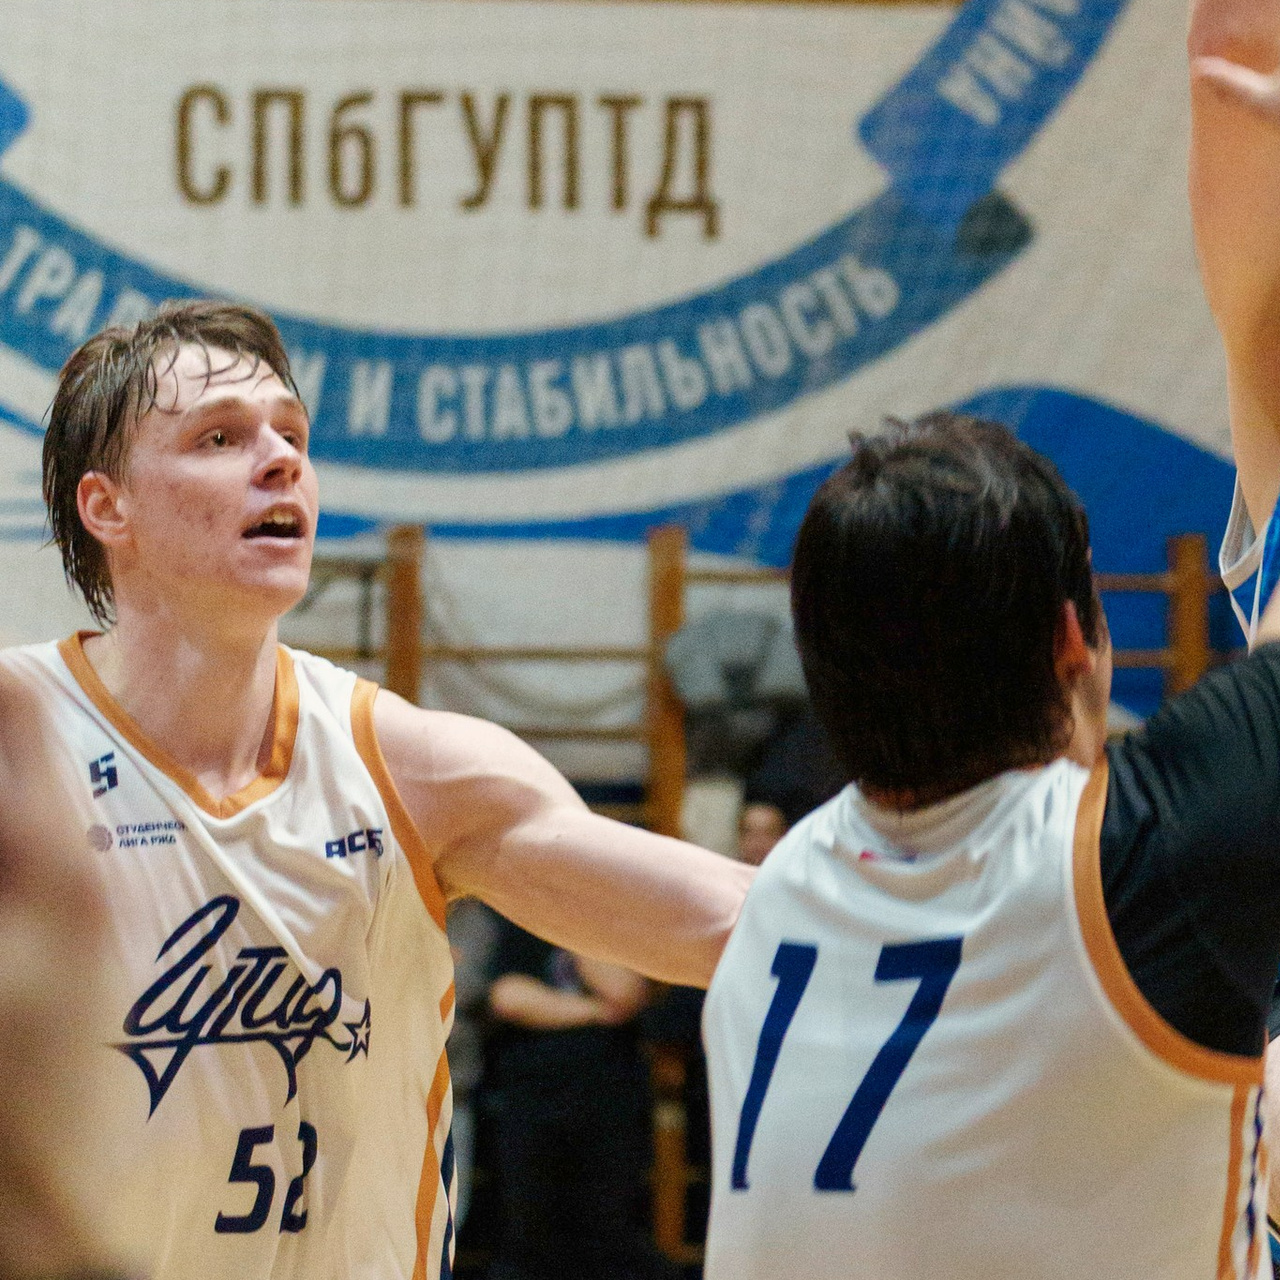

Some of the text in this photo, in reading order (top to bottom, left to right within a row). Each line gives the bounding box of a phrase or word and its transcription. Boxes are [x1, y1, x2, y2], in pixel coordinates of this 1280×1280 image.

[172, 83, 722, 240] СПбГУПТД
[347, 357, 393, 436] И
[415, 254, 901, 445] СТАБИЛЬНОСТЬ
[119, 835, 149, 848] ЛИГА
[730, 933, 965, 1194] 17
[214, 1119, 318, 1234] 52
